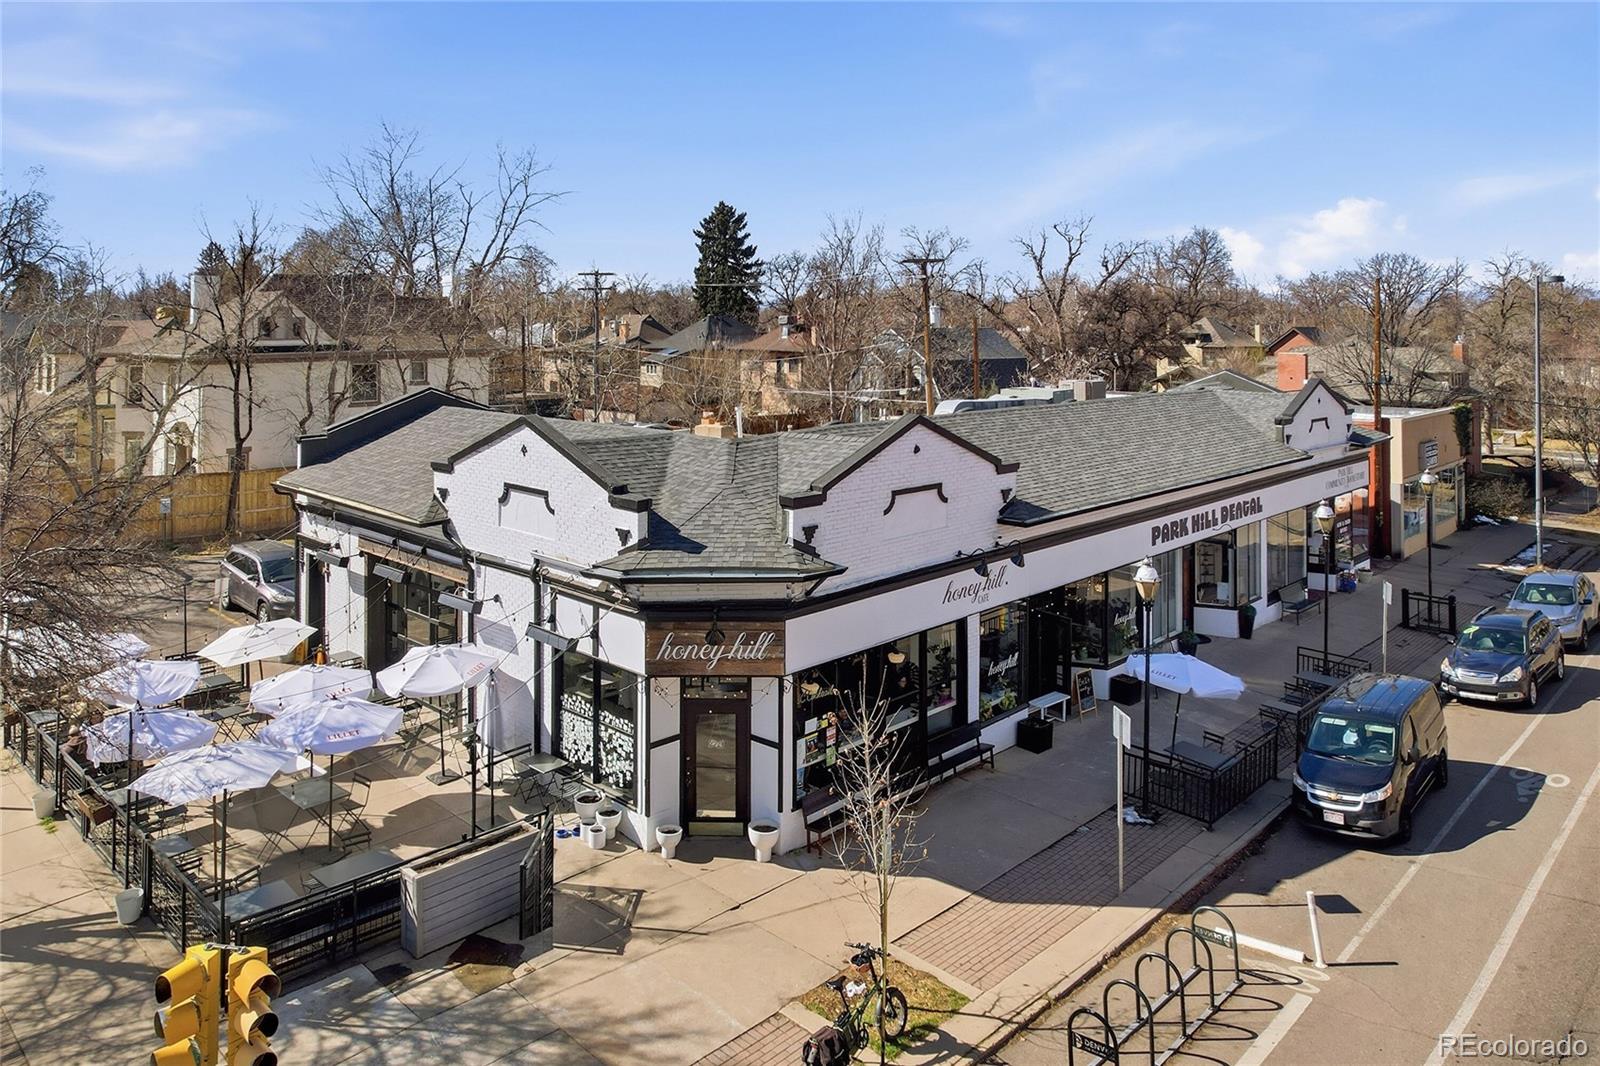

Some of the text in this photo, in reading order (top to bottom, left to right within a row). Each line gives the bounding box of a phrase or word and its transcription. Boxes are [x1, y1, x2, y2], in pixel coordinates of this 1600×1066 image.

[1151, 516, 1190, 547] PARK
[942, 579, 982, 605] honey
[656, 631, 776, 670] honey hill
[327, 728, 361, 741] LILLET
